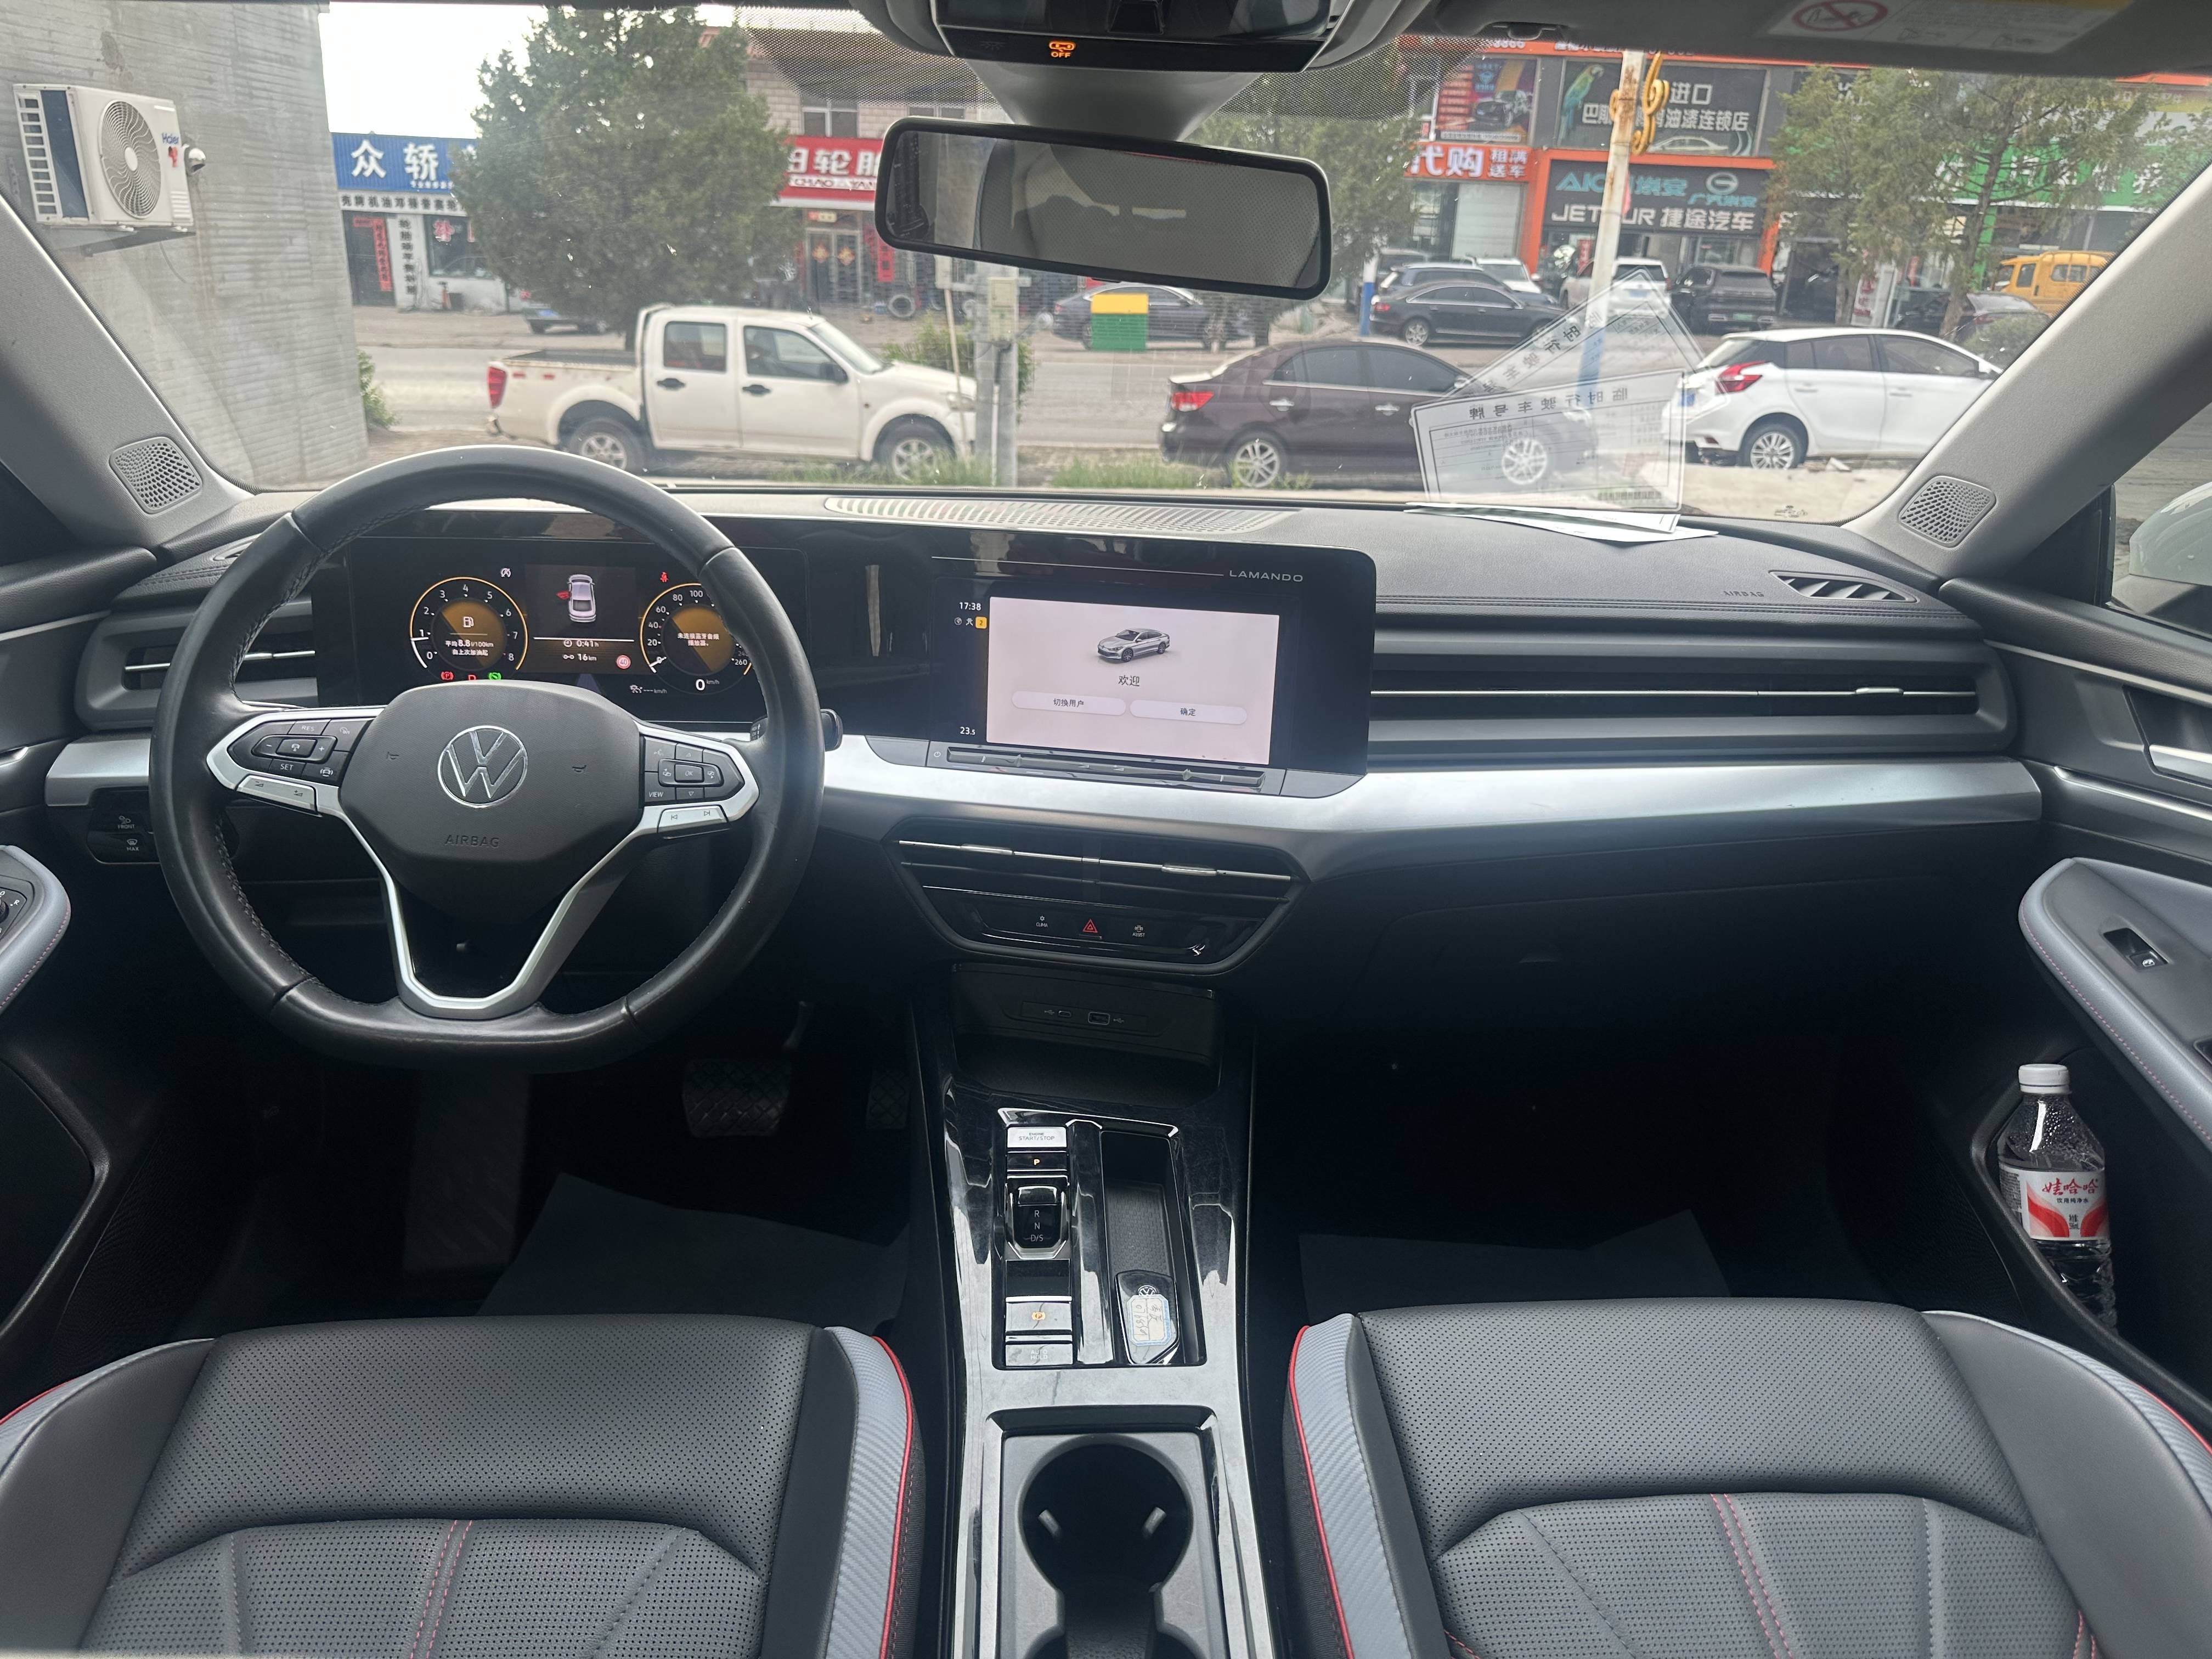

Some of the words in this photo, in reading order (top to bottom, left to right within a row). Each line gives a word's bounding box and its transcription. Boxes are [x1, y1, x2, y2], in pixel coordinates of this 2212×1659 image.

[1669, 82, 1713, 105] 进口
[161, 133, 179, 144] Haier
[1410, 145, 1483, 178] 代购
[1551, 204, 1656, 225] JETUR
[1660, 207, 1756, 231] 捷途汽车
[1229, 570, 1304, 582] LAMANDO
[959, 602, 981, 611] 17:38
[426, 651, 433, 659] 0
[509, 653, 515, 661] 8
[696, 679, 706, 690] 0
[1118, 675, 1140, 686] 欢迎
[1053, 698, 1084, 707] 切换用户
[1180, 708, 1196, 716] 确定
[960, 726, 975, 735] 23.5
[445, 834, 500, 848] AIRBAG
[2042, 1177, 2098, 1195] 娃哈哈
